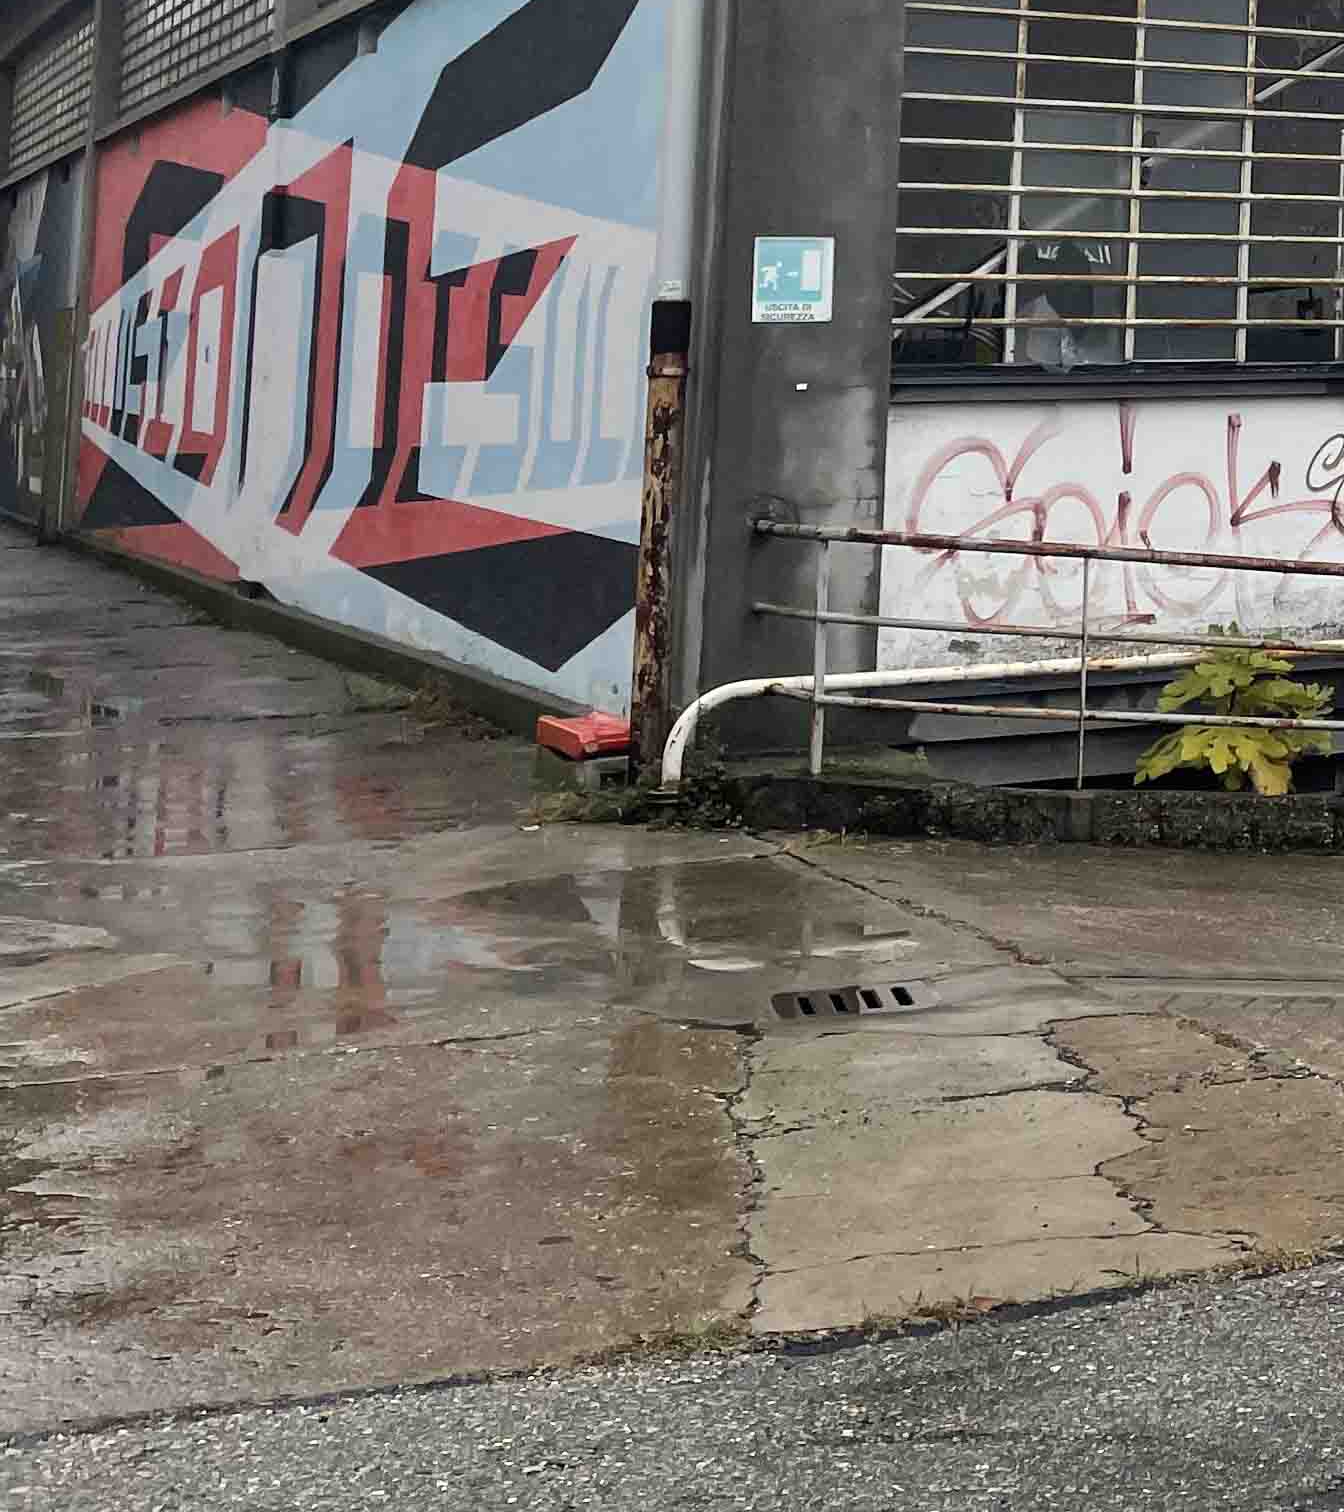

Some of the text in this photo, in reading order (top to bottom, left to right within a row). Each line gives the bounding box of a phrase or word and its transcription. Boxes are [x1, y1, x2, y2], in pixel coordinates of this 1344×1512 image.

[764, 303, 812, 311] USCITA DI
[761, 313, 815, 321] SICUREZZA
